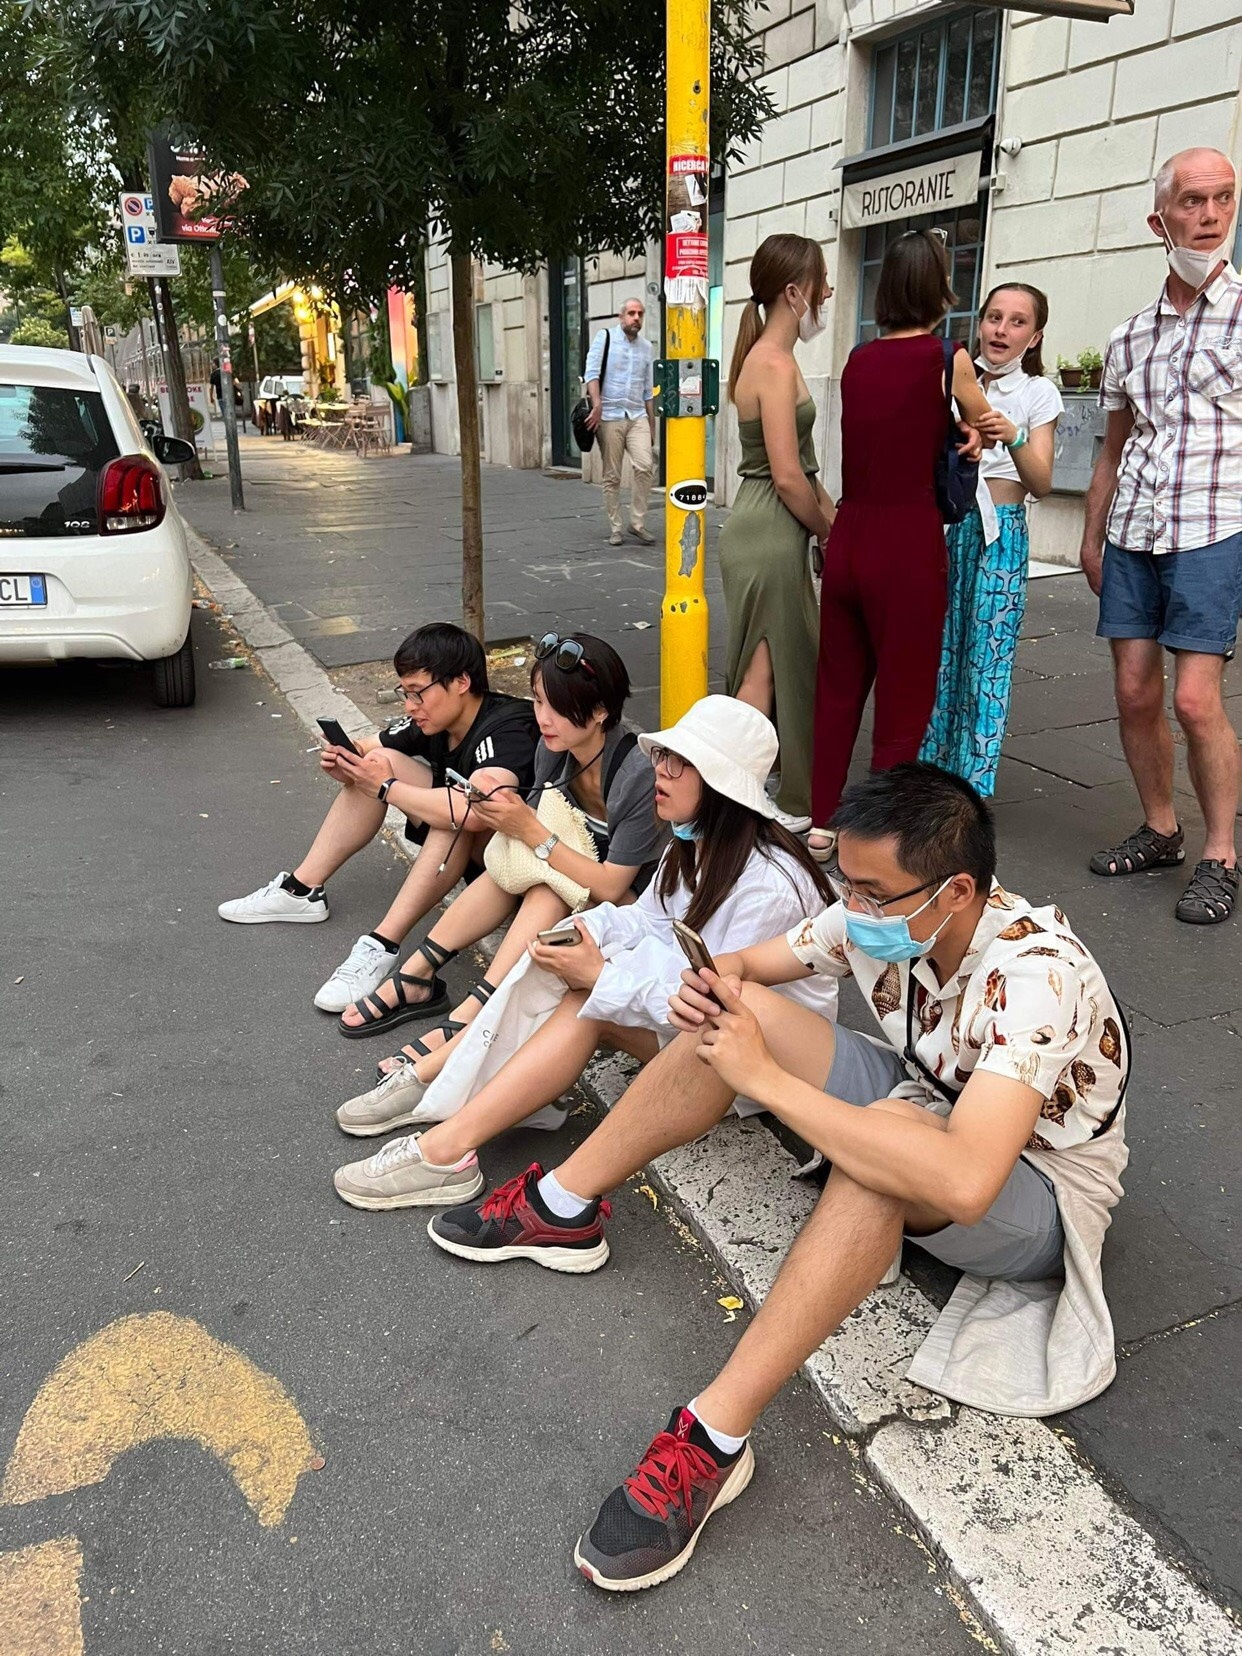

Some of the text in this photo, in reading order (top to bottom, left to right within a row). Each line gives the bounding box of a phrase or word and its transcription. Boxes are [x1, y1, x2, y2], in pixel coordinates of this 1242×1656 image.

[673, 160, 705, 172] RICERCA
[861, 169, 956, 218] RISTORANTE
[181, 224, 192, 232] via
[131, 228, 142, 242] P
